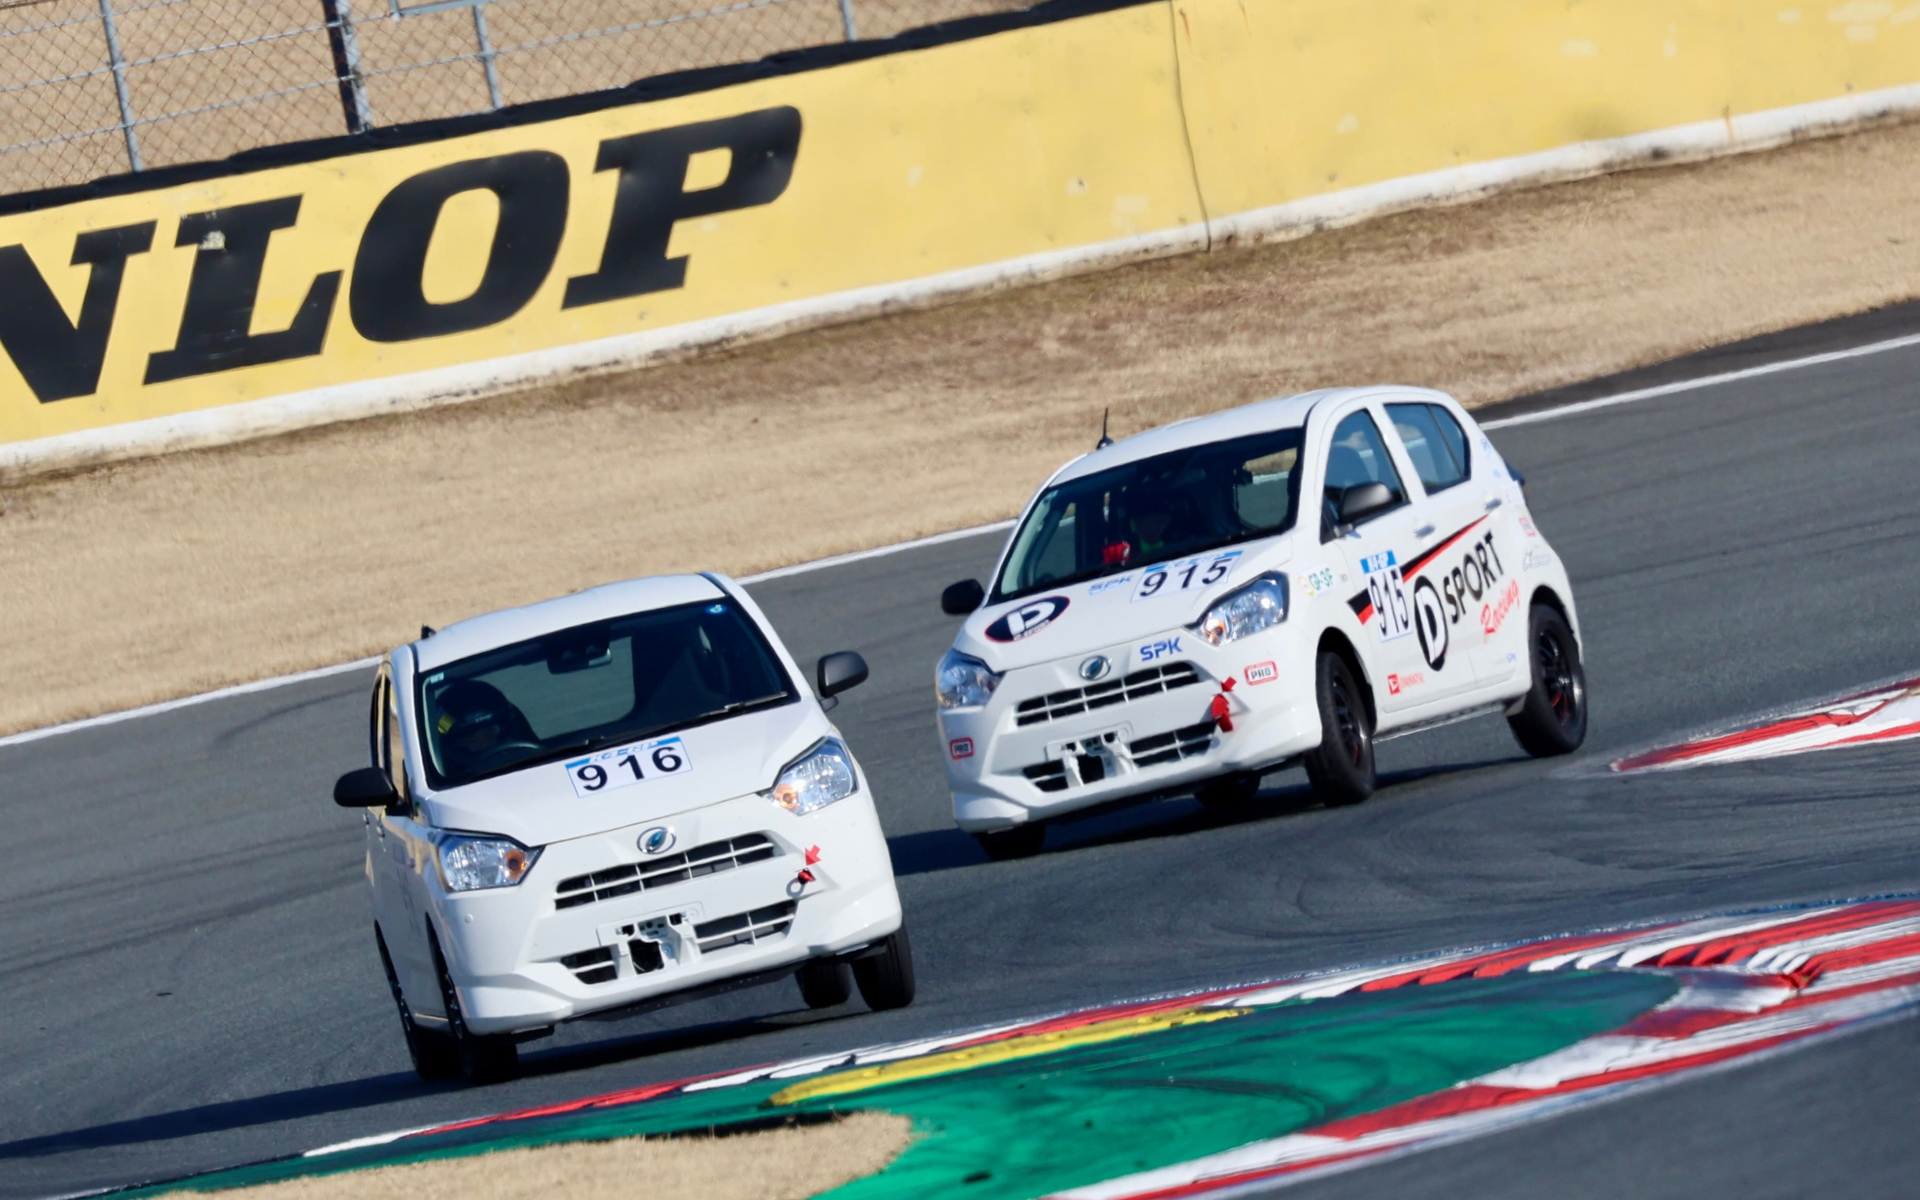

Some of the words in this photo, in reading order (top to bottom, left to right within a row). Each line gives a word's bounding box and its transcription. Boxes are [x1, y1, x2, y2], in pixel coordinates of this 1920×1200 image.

[1139, 558, 1233, 597] 915
[1369, 569, 1409, 637] 915
[1443, 528, 1505, 624] SPORT
[1480, 579, 1520, 644] Racing
[1139, 637, 1183, 662] SPK
[577, 746, 682, 791] 916
